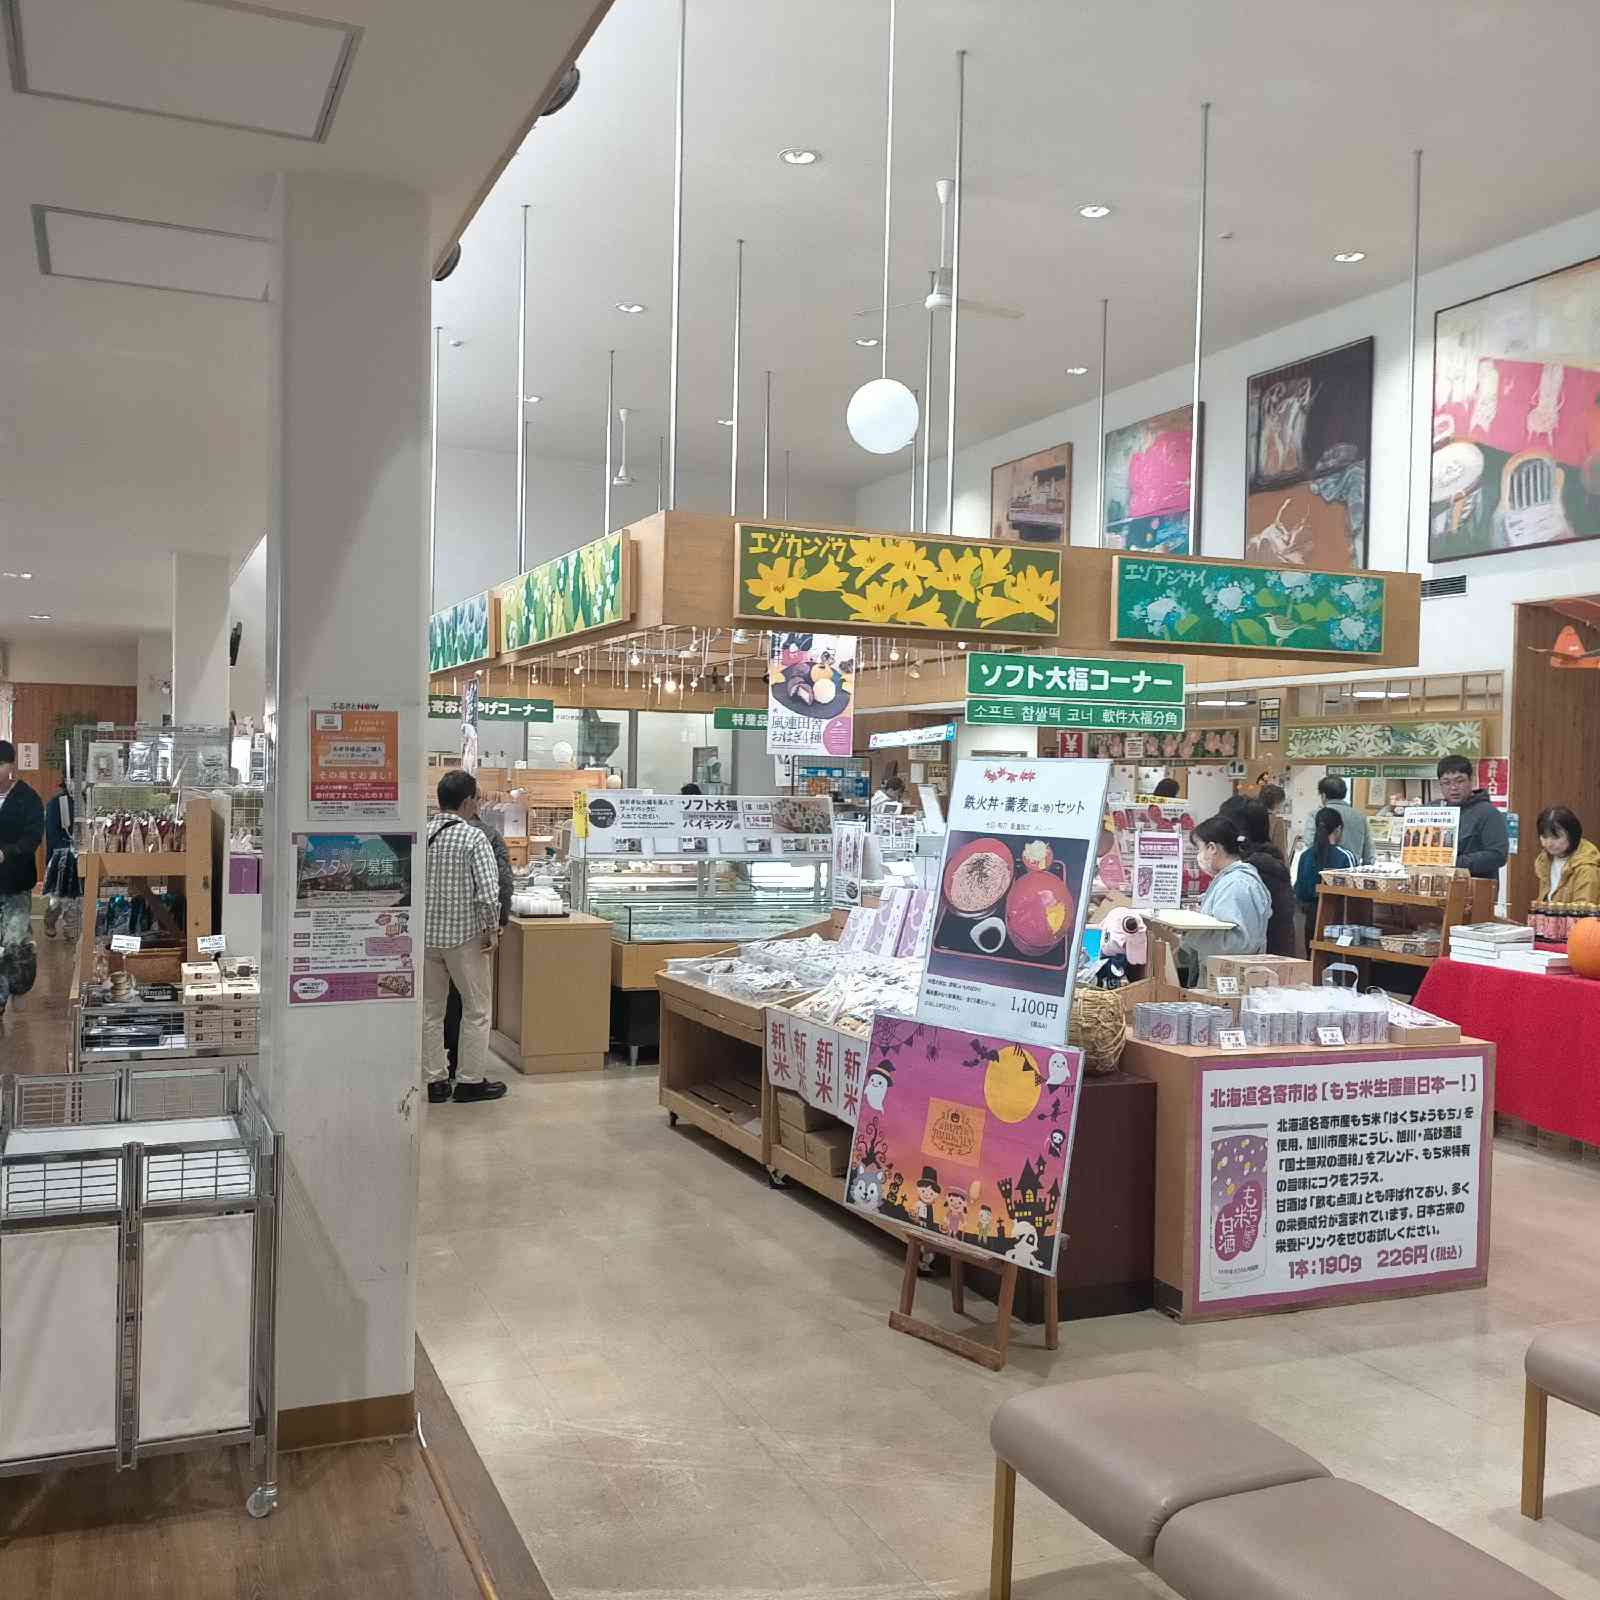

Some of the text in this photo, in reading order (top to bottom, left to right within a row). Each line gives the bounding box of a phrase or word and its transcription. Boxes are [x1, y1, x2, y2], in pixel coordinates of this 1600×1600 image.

[748, 531, 848, 562] エゾカンゾウ
[980, 664, 1173, 694] ソフト大福コーナー
[1022, 706, 1061, 722] 찹쌀떡
[1067, 708, 1094, 723] 코너
[1103, 710, 1177, 726] 軟件大福分角
[681, 799, 738, 812] ソフト大福
[682, 819, 735, 830] バイキング
[315, 858, 394, 876] スタッフ募集
[1010, 996, 1058, 1020] 1,100円
[772, 1021, 791, 1080] 新米
[815, 1038, 833, 1103] 新米
[844, 1048, 861, 1116] 新米
